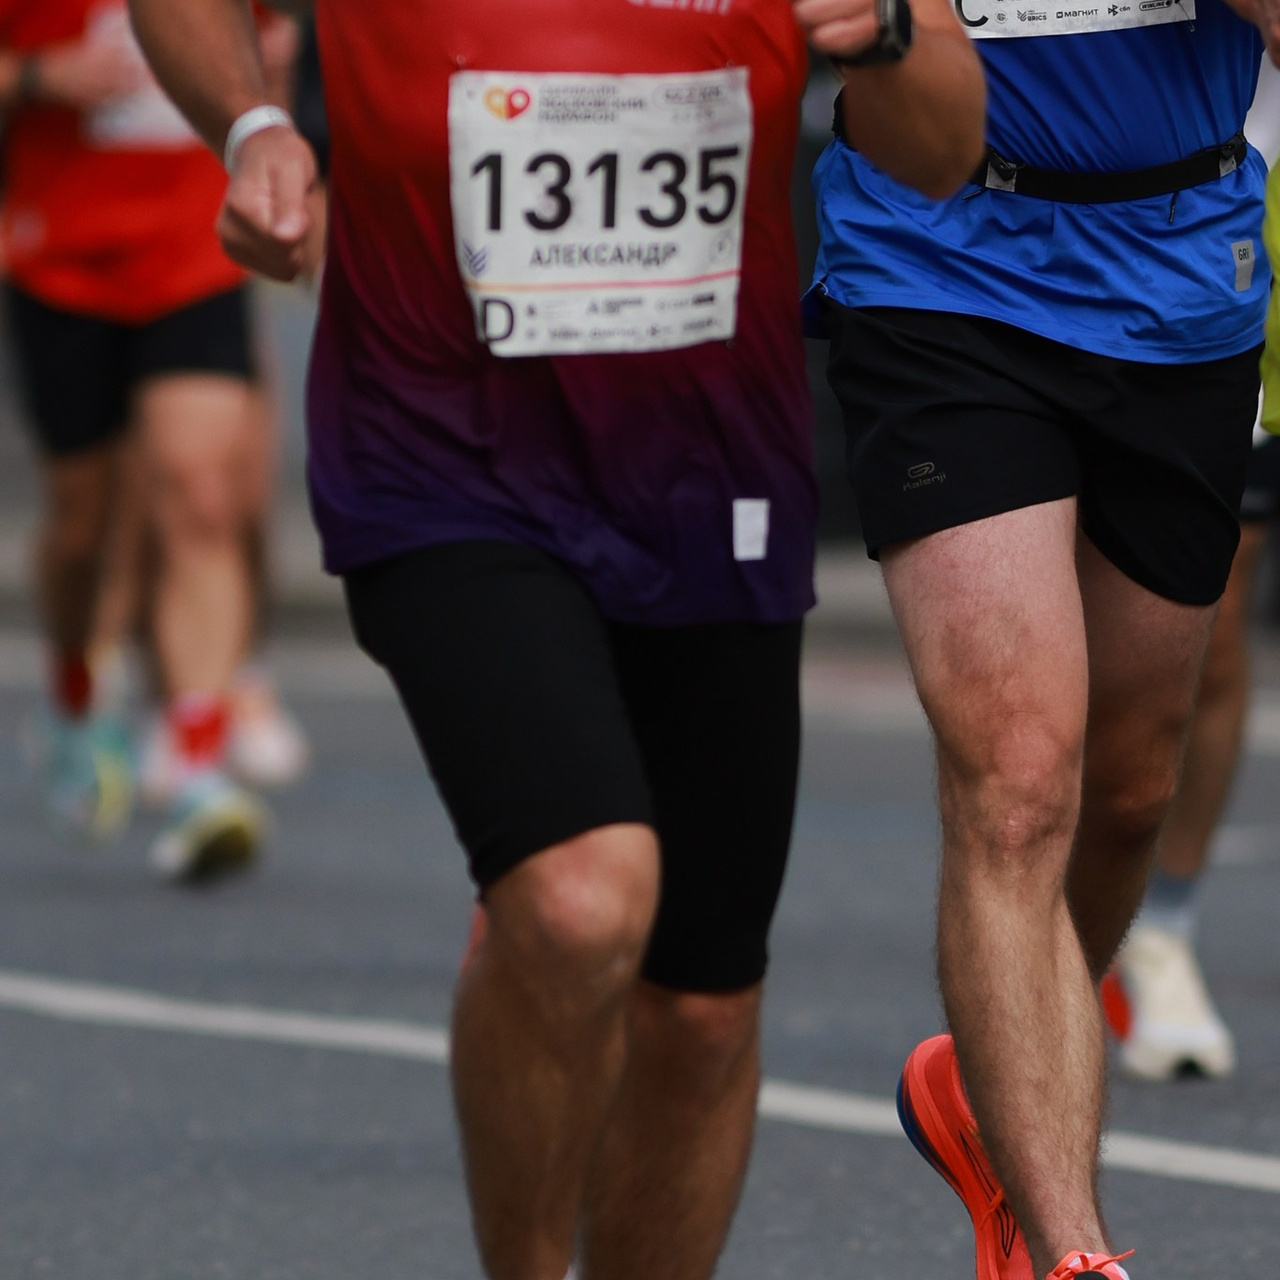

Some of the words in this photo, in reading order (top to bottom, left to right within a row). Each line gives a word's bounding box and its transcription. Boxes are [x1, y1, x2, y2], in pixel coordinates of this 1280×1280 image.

[470, 144, 740, 232] 13135
[529, 241, 680, 269] АЛЕКСАНДР
[480, 297, 515, 343] D
